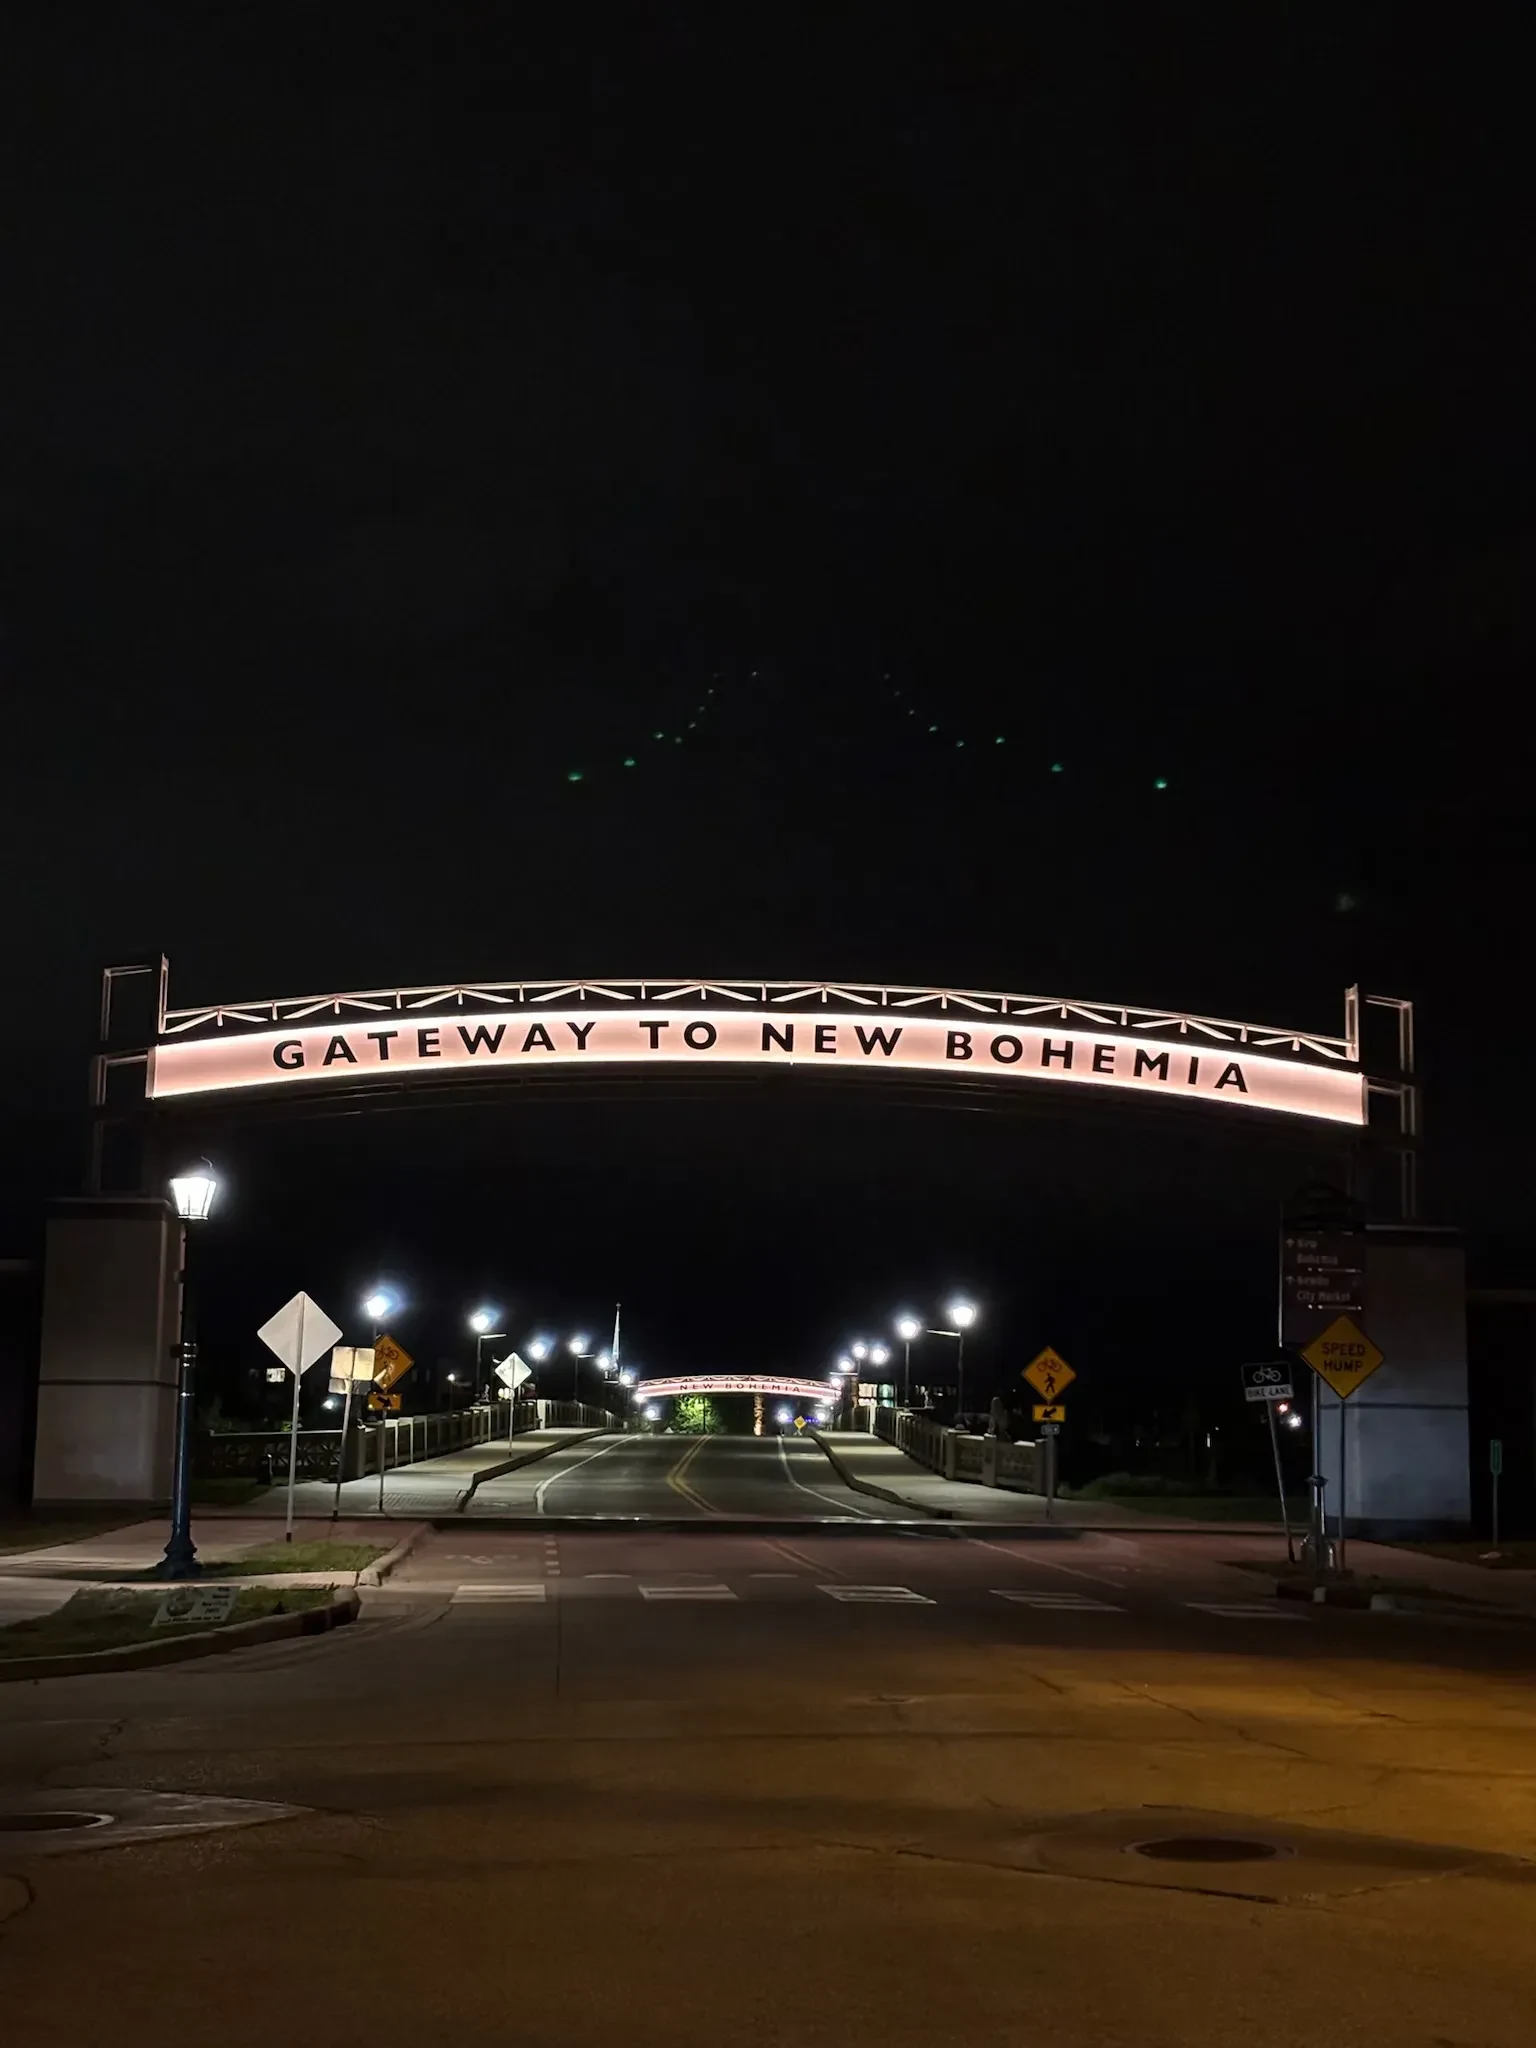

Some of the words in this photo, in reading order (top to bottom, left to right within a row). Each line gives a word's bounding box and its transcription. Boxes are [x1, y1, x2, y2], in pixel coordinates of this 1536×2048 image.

[272, 1021, 597, 1070] GATEWAY
[639, 1020, 718, 1050] TO
[760, 1022, 904, 1057] NEW
[945, 1030, 1249, 1094] BOHEMIA
[1321, 1341, 1366, 1357] SPEED
[1323, 1359, 1364, 1373] HUMP
[725, 1383, 800, 1392] BOHEMIA
[1247, 1387, 1266, 1398] BIKE
[1268, 1385, 1292, 1396] LANE
